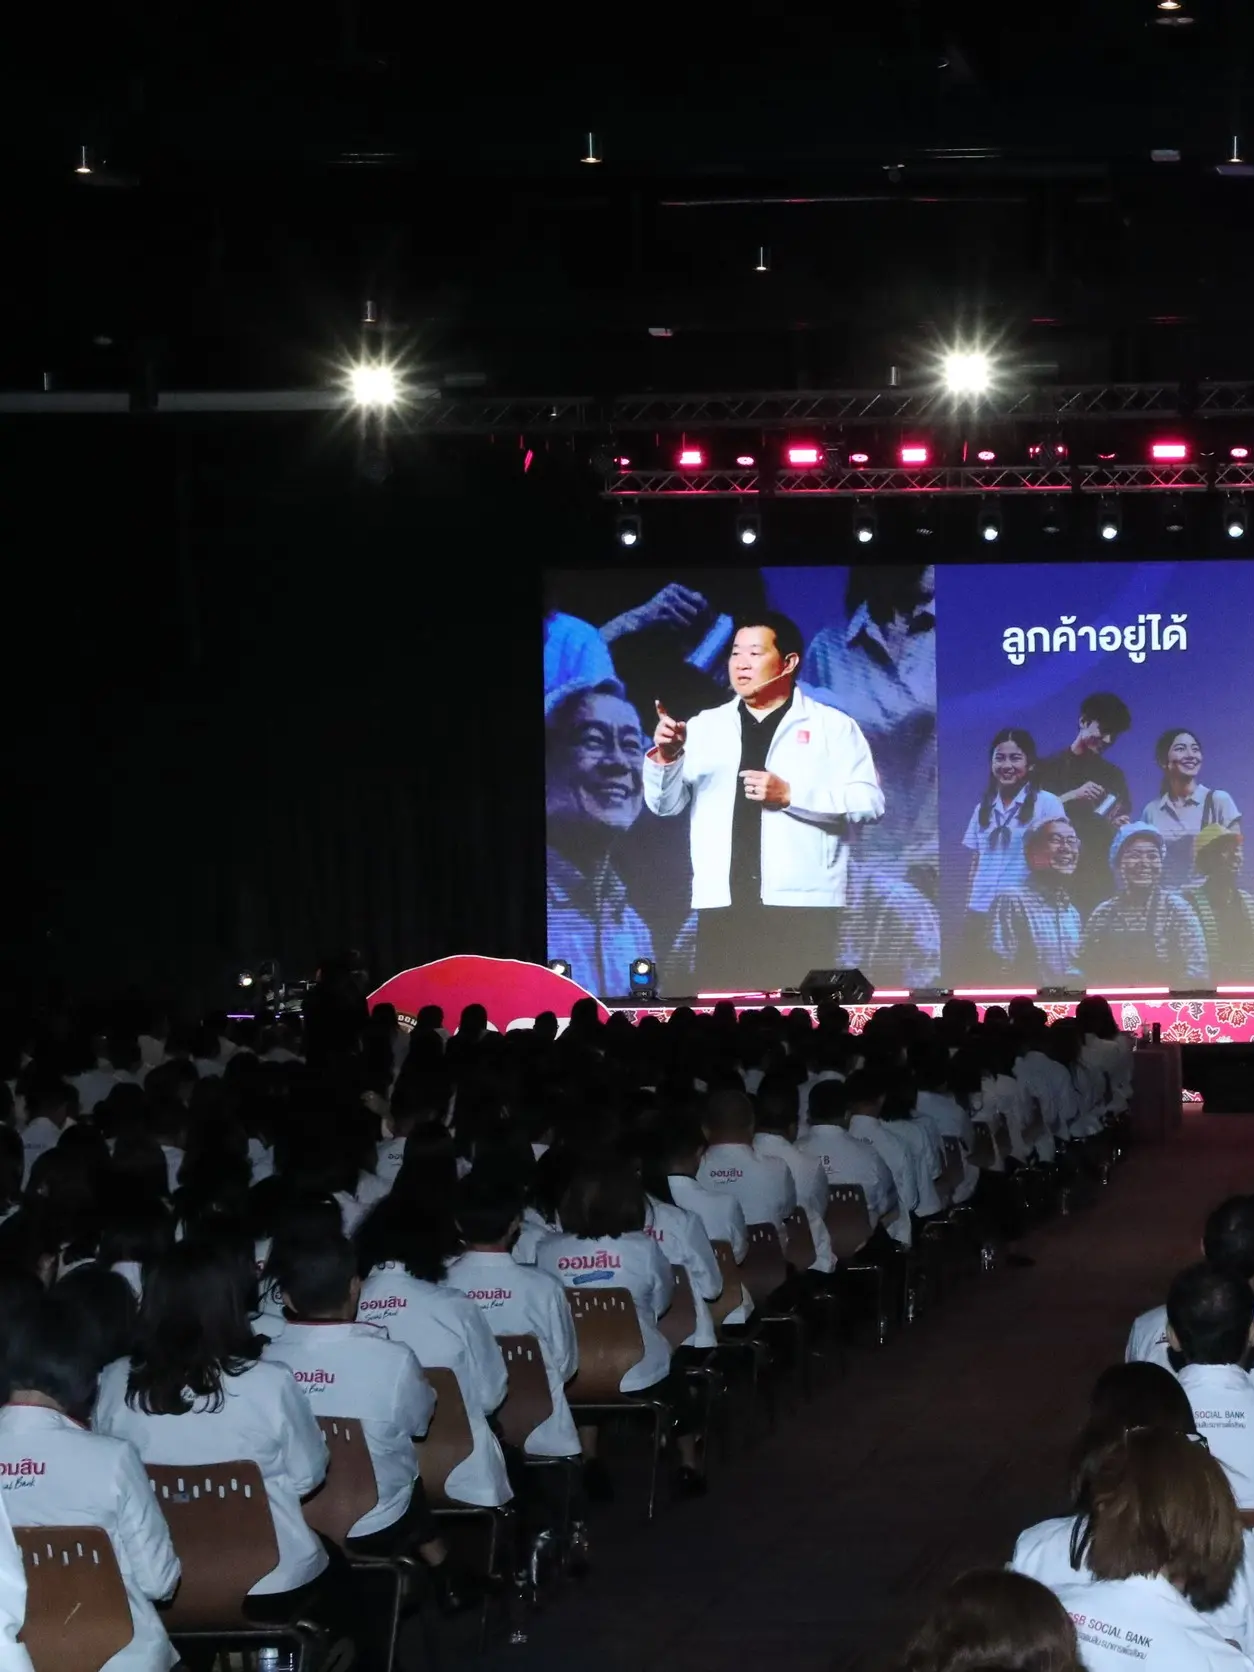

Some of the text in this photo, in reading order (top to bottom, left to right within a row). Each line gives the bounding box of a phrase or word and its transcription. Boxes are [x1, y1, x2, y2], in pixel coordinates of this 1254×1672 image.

[1003, 614, 1188, 665] ลูกค้าอยู่ได้
[710, 1168, 743, 1178] ออมสิน
[559, 1250, 621, 1270] ออมสิน
[467, 1287, 511, 1299] ออมสิน
[360, 1296, 407, 1310] ออมสิน
[294, 1369, 335, 1384] อมสิน
[1194, 1410, 1245, 1419] SOCIAL BANK
[0, 1458, 46, 1476] อมสิน
[1088, 1618, 1121, 1639] SOCIAL
[1125, 1631, 1153, 1647] BANK
